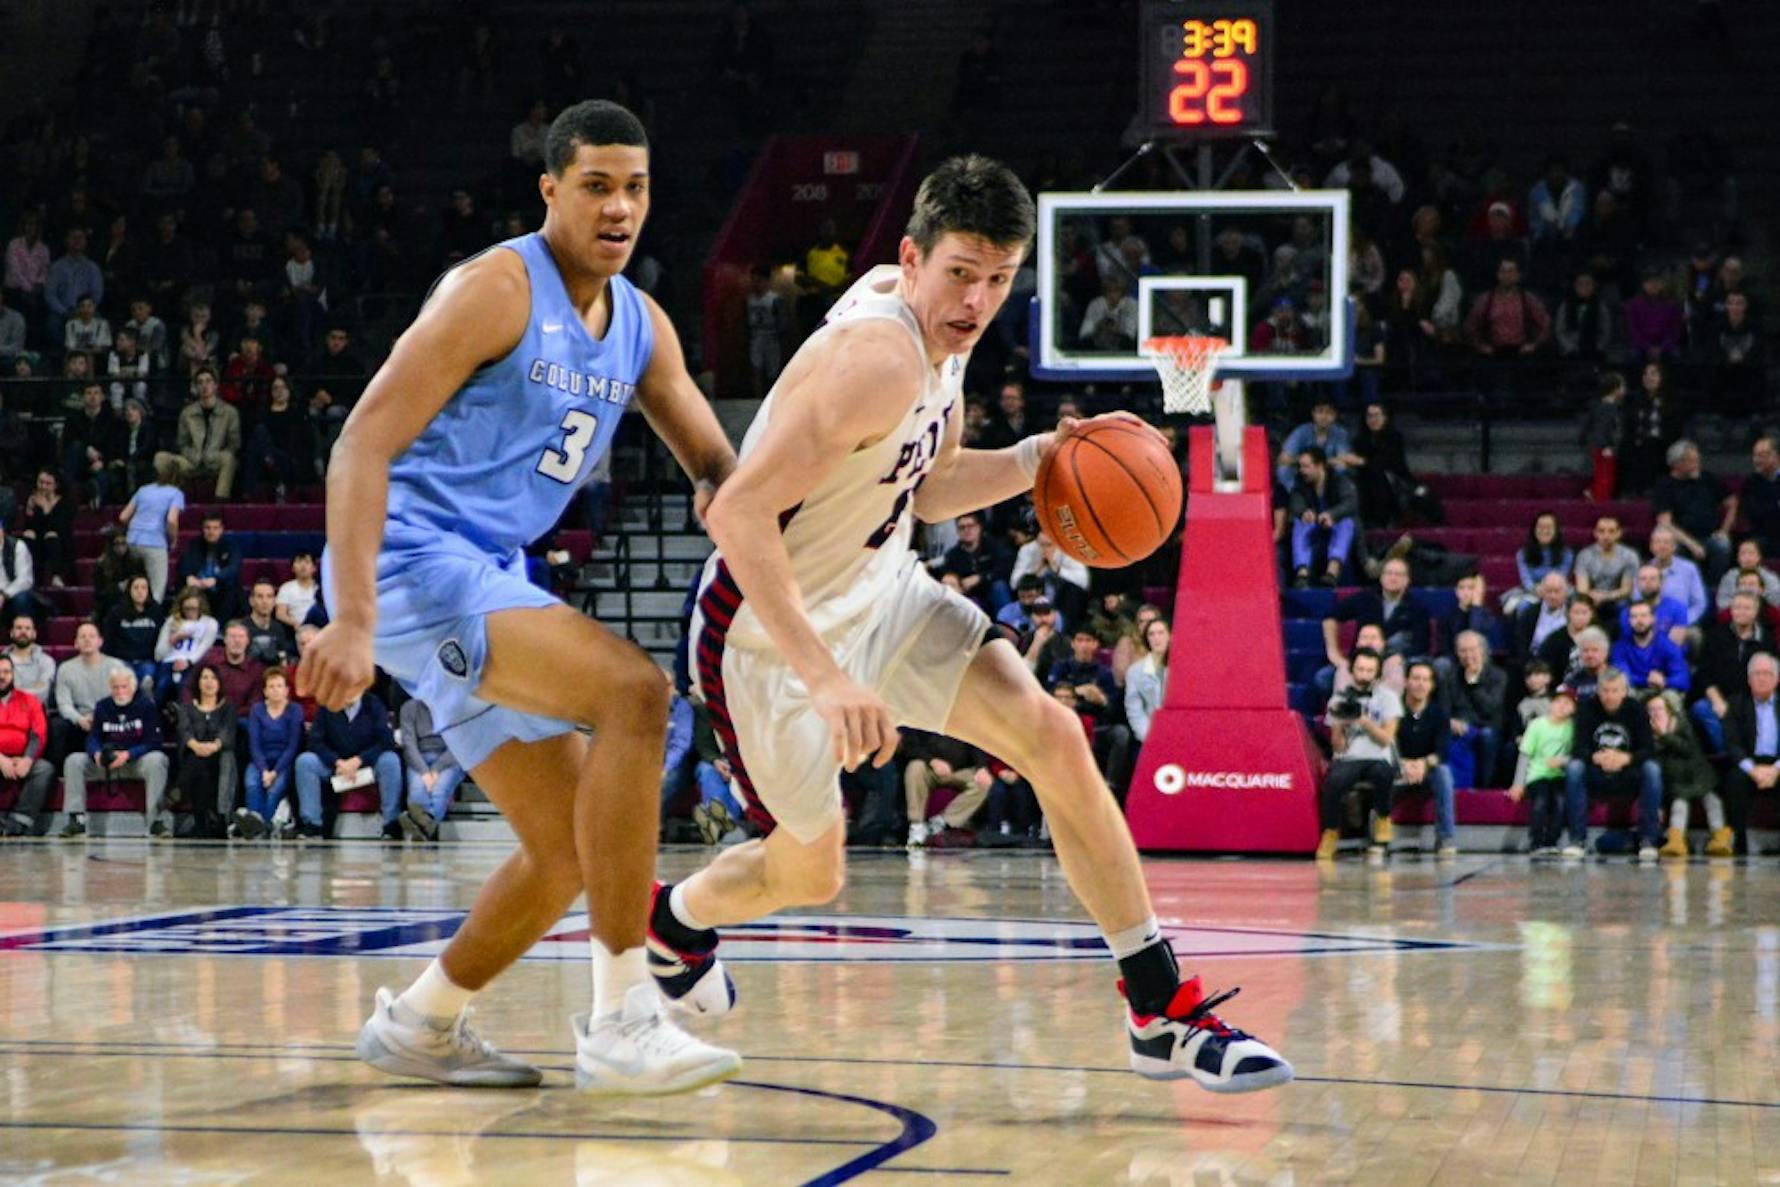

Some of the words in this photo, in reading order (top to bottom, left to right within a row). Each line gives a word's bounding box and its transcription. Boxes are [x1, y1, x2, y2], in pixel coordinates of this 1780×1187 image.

[1183, 19, 1257, 57] 3:39
[1169, 59, 1247, 123] 22
[529, 359, 636, 405] COLUMBI
[535, 408, 598, 484] 3
[1187, 771, 1293, 790] MACQUARIE
